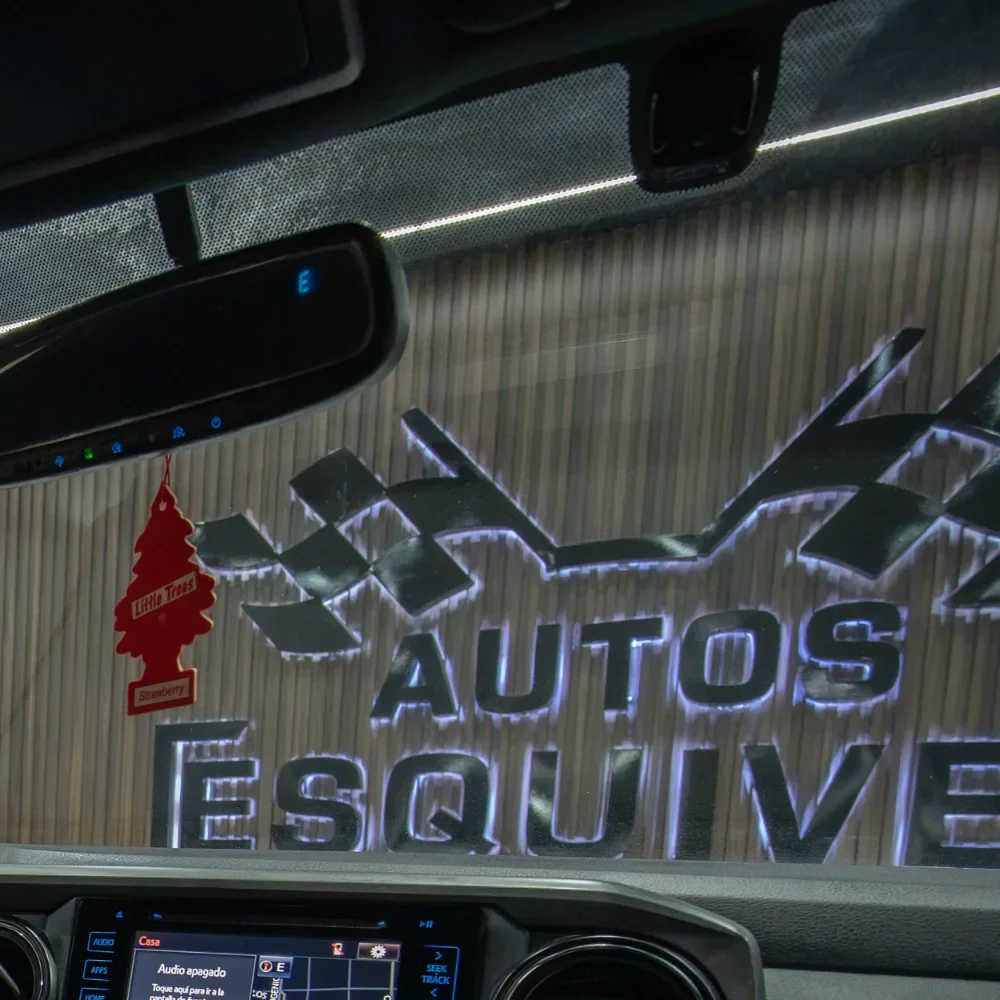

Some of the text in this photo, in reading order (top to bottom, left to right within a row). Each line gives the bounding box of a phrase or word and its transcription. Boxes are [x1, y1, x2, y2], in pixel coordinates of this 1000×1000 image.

[299, 270, 310, 294] E
[134, 576, 194, 618] Little Trees
[370, 600, 903, 720] AUTOS
[139, 683, 185, 702] Strawberry
[93, 938, 115, 947] AUDIO
[138, 936, 160, 947] Casa
[90, 966, 108, 975] APPS
[157, 963, 227, 978] Audio apagado
[276, 962, 285, 972] E
[426, 964, 447, 973] SEEK
[421, 975, 450, 985] TRACK
[152, 983, 173, 994] Toque
[173, 986, 189, 996] aquí
[189, 987, 205, 996] para
